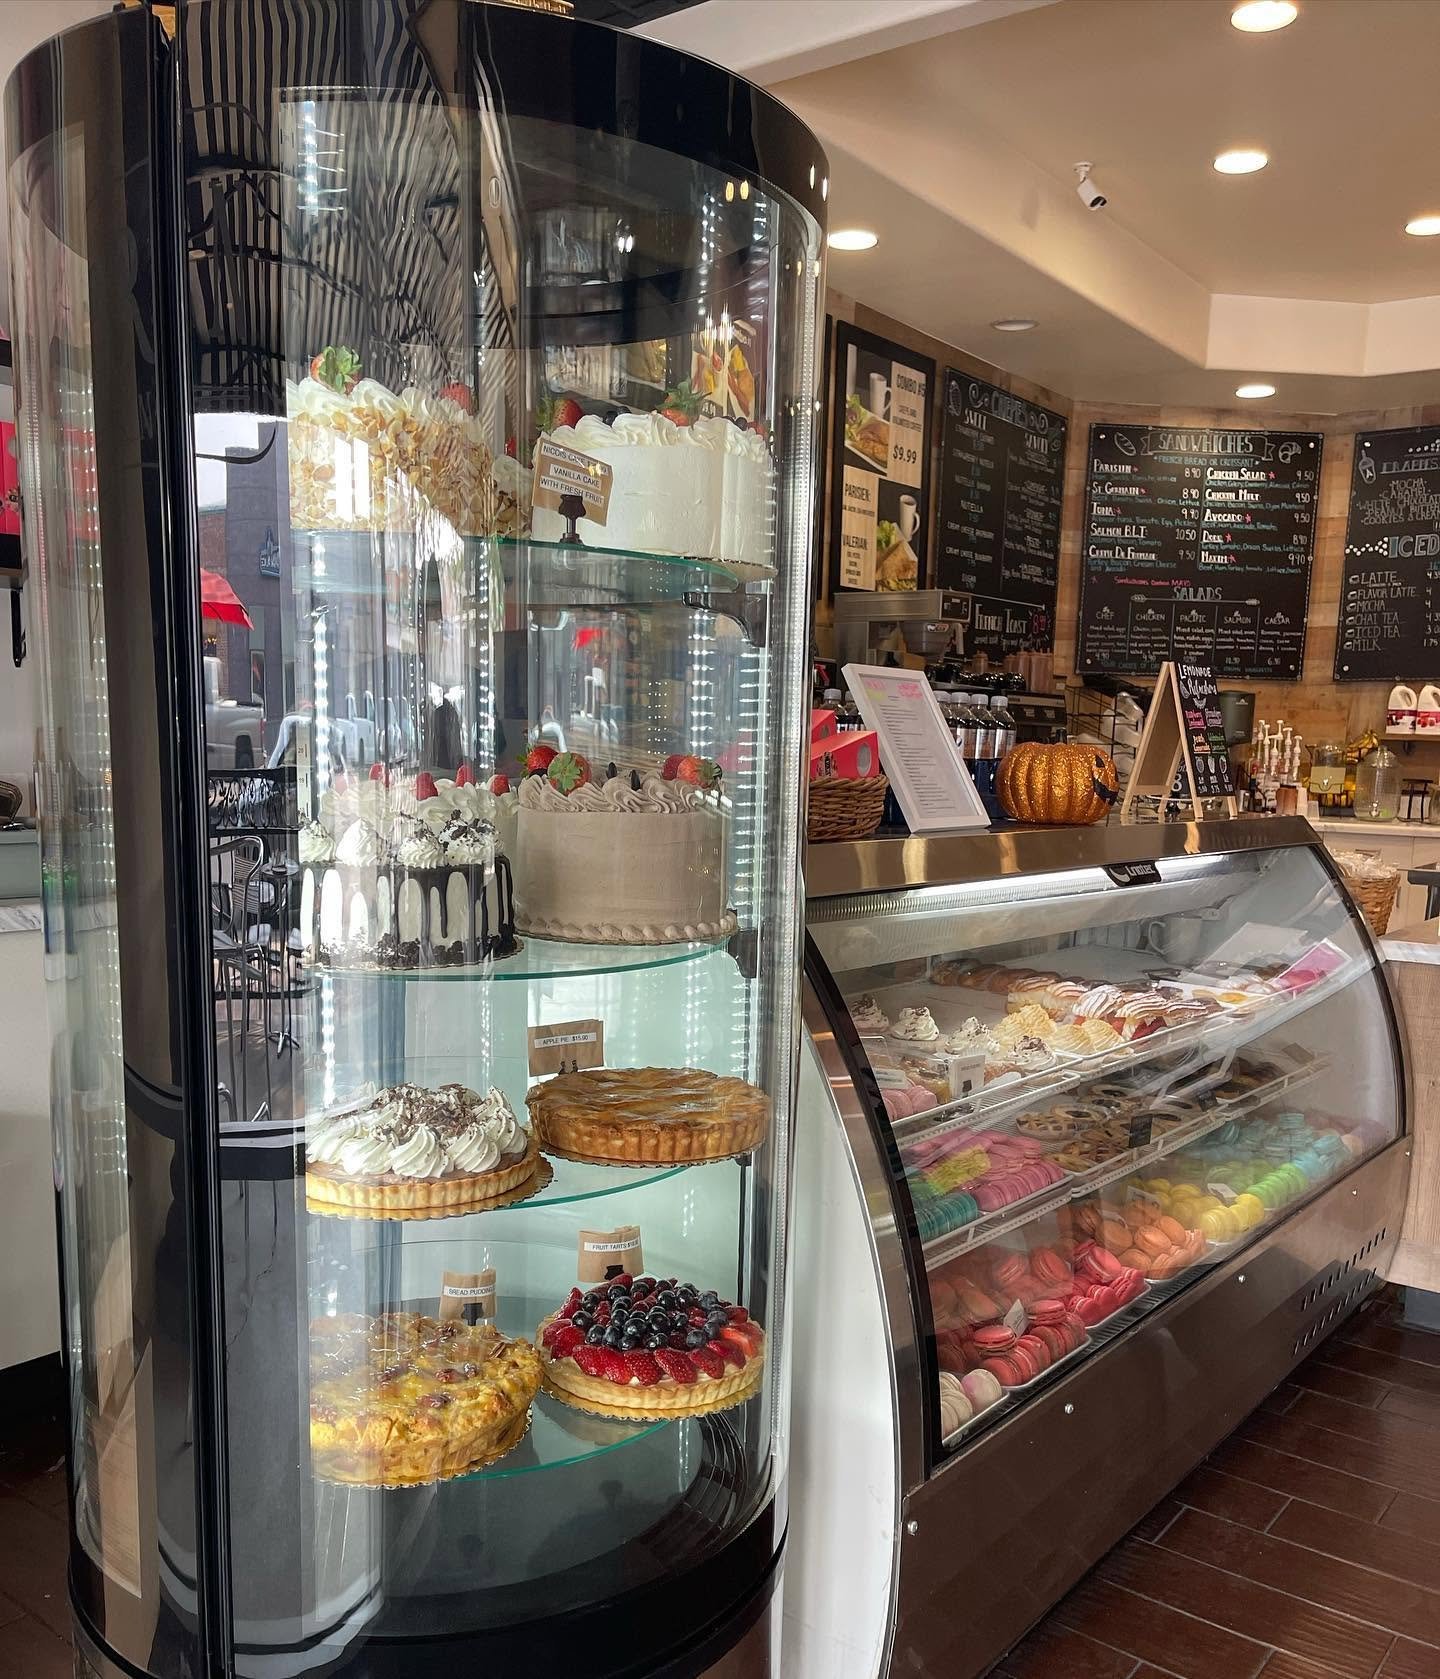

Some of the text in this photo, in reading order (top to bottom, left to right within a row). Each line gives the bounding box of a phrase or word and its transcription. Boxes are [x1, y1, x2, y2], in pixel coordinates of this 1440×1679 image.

[892, 445, 918, 464] $9.99
[553, 466, 581, 480] VANILLA
[582, 475, 600, 489] CAKE
[541, 478, 603, 504] WITH FRESH FRUIT
[1397, 494, 1440, 508] CHOCOLAT
[1389, 534, 1440, 558] ICED
[1361, 571, 1397, 585] LATTE
[1174, 587, 1223, 600] SALADS
[1357, 589, 1388, 600] FLAVOR
[1390, 587, 1417, 599] LATTE
[1356, 600, 1386, 613] MOCHA
[1096, 611, 1115, 620] CHEF
[1135, 613, 1166, 621] CHICKEN
[1264, 617, 1290, 625] CAESAR
[1355, 612, 1400, 625] CHAI TEA
[1354, 625, 1400, 640] ICED TEA
[1352, 639, 1382, 653] MILK
